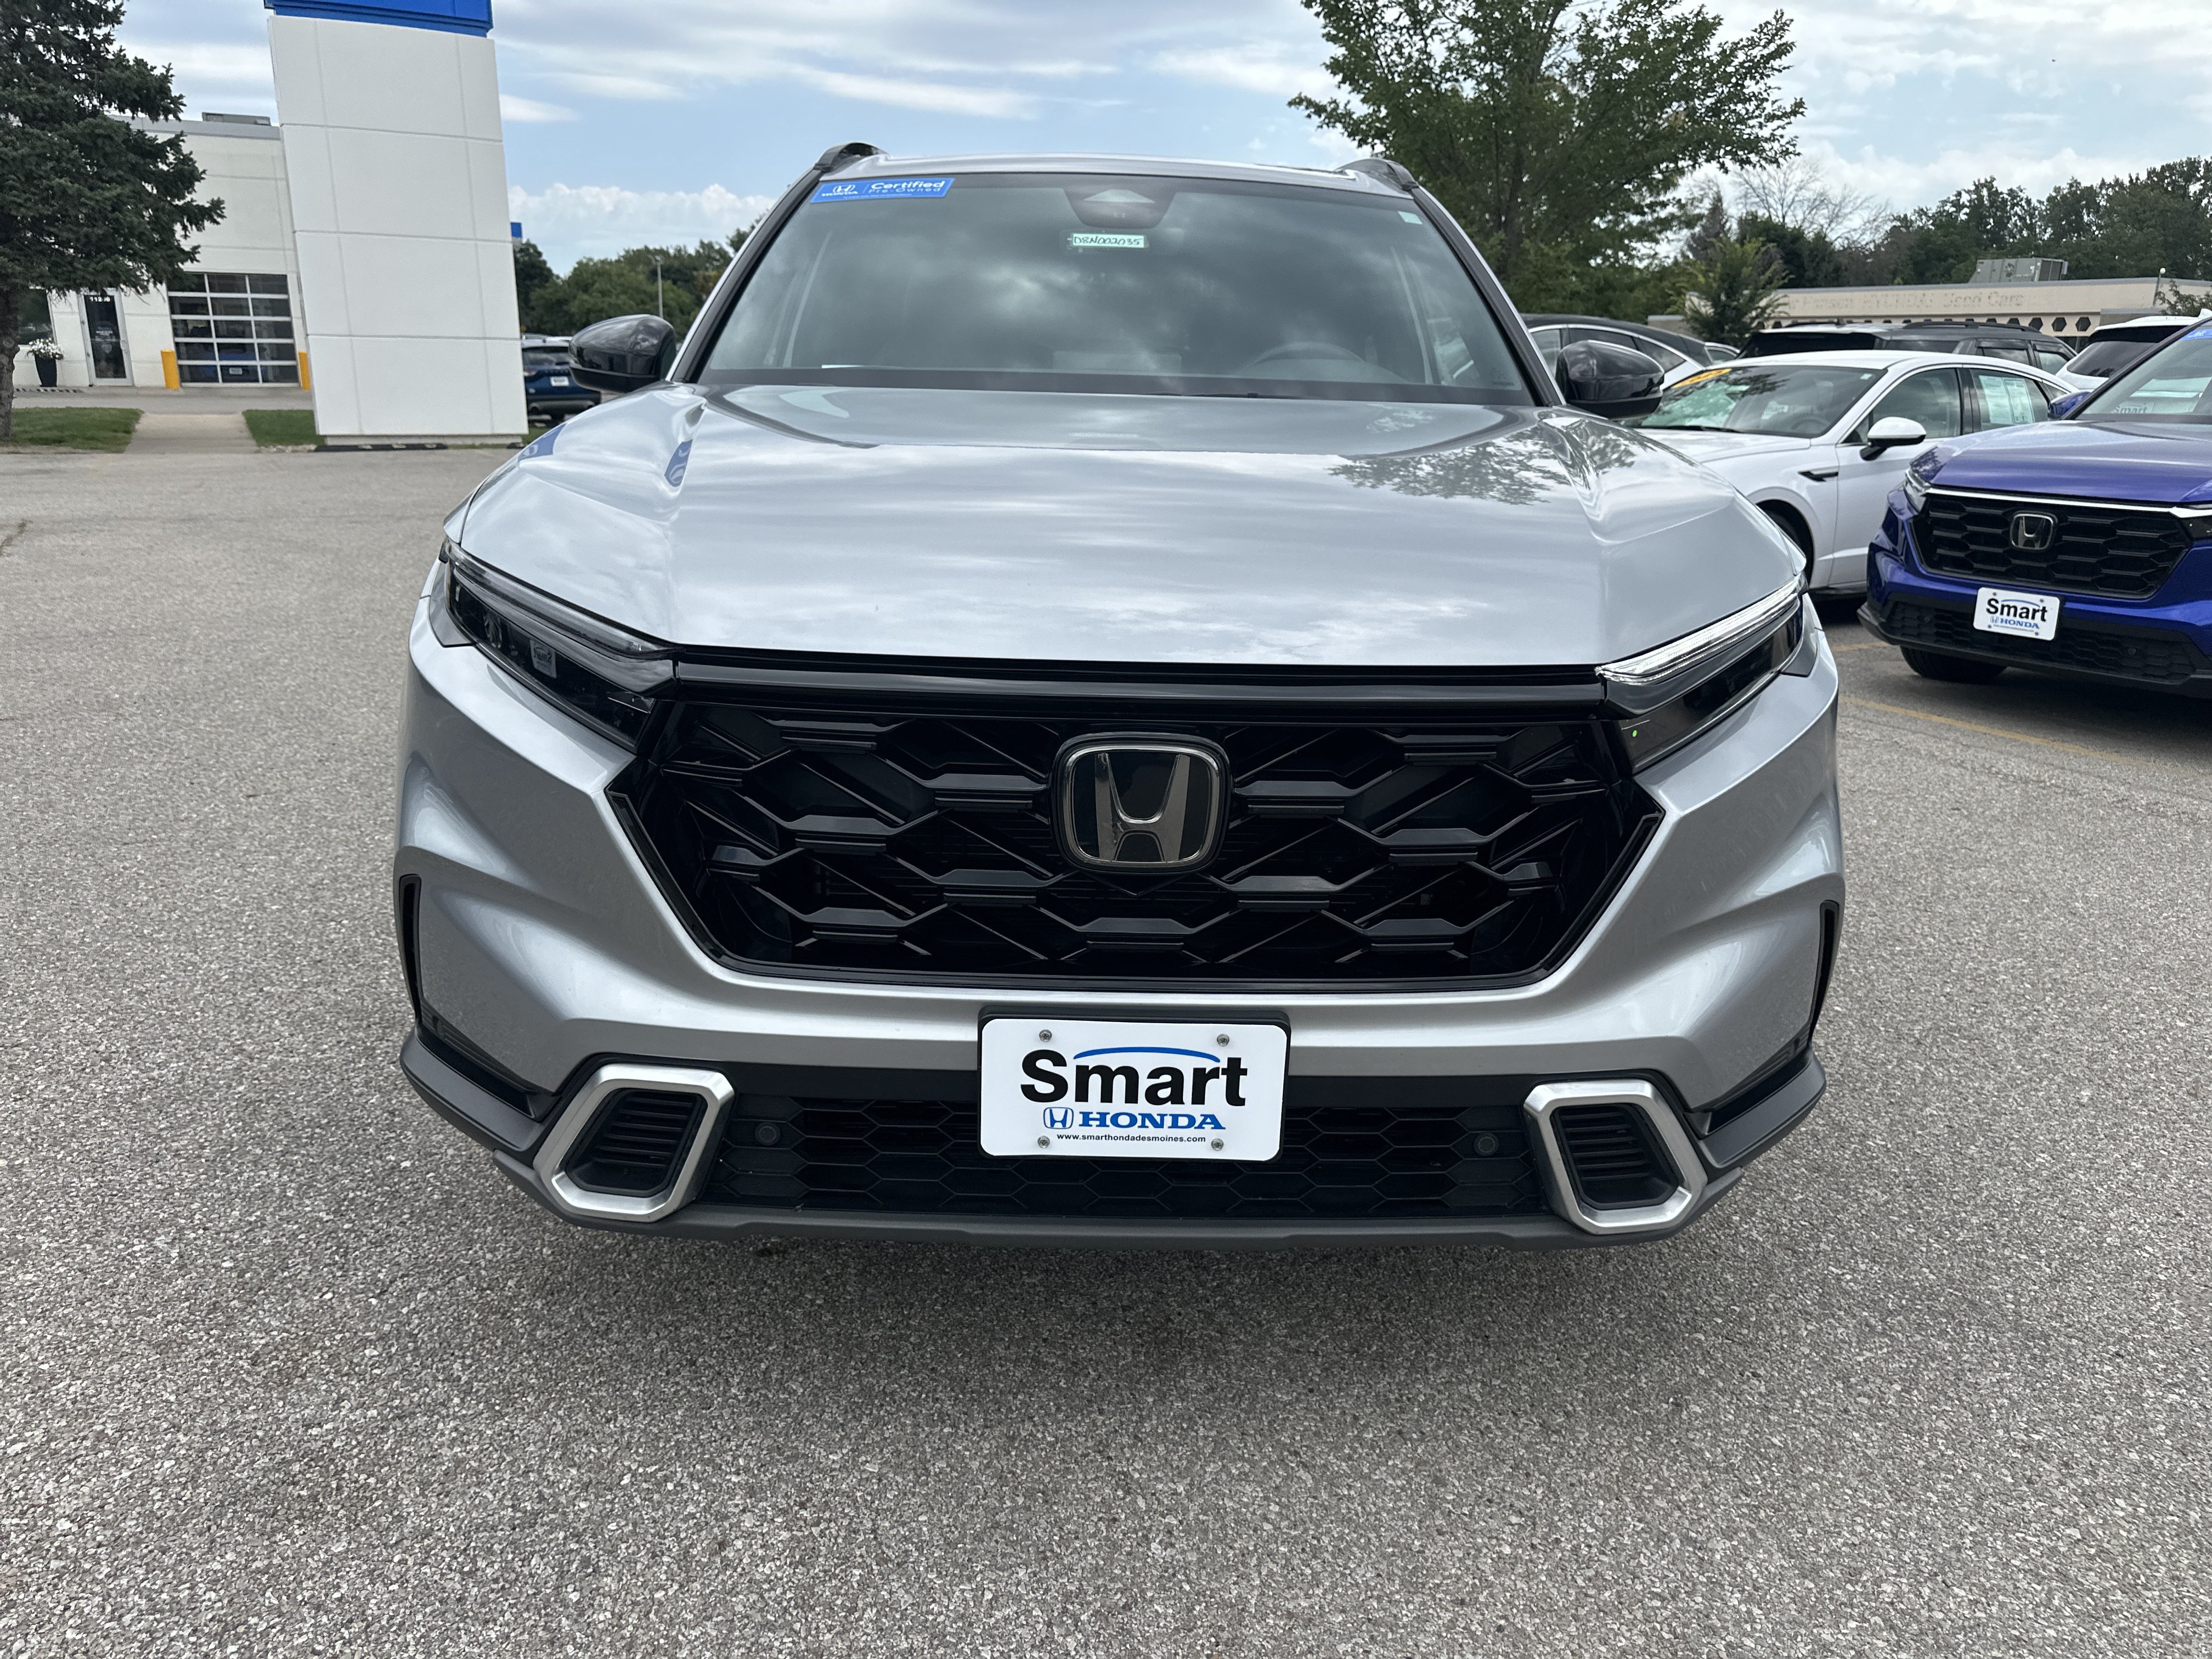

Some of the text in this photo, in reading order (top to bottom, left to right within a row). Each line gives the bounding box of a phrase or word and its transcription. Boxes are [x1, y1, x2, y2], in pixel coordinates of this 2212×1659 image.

[871, 180, 945, 189] Certified
[1986, 597, 2047, 622] Smart
[2000, 619, 2040, 629] HONDA
[1020, 1049, 1248, 1107] Smart
[1079, 1111, 1226, 1130] HONDA
[1057, 1133, 1206, 1143] www.smarthondadesmoines.com
